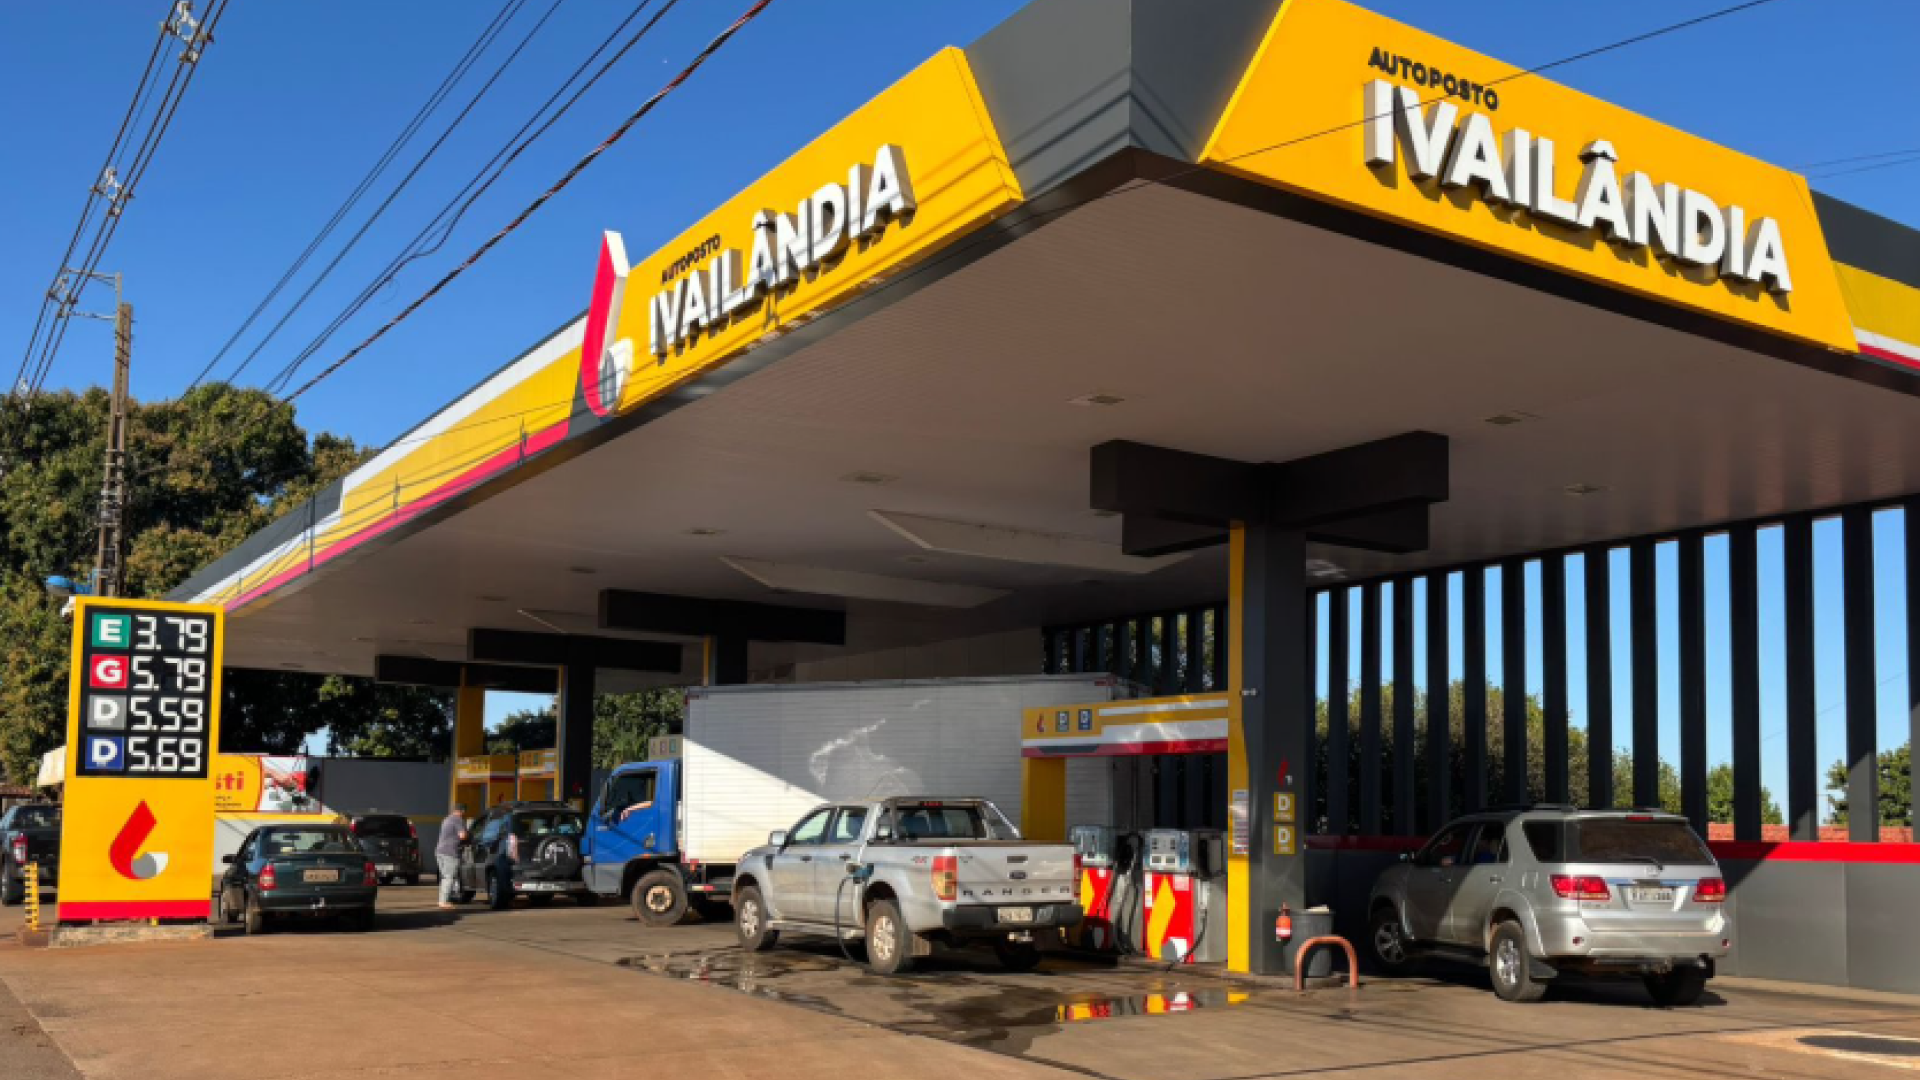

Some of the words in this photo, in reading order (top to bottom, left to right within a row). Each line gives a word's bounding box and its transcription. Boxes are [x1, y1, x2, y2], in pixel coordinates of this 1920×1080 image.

[1368, 47, 1499, 111] AUTOPOSTO
[1364, 78, 1792, 294] IVAILÂNDIA
[650, 143, 914, 356] IVAILÂNDIA
[661, 233, 721, 285] AUTOPOSTO
[98, 618, 123, 643] E
[134, 614, 208, 653] 3.79
[95, 658, 123, 683] G
[131, 655, 206, 693] 5.79
[93, 697, 120, 721] D
[130, 696, 204, 732] 5.59
[91, 737, 118, 763] D
[128, 736, 202, 772] 5.69
[1278, 795, 1291, 811] D
[1278, 827, 1291, 843] D
[962, 885, 1070, 897] RANGER
